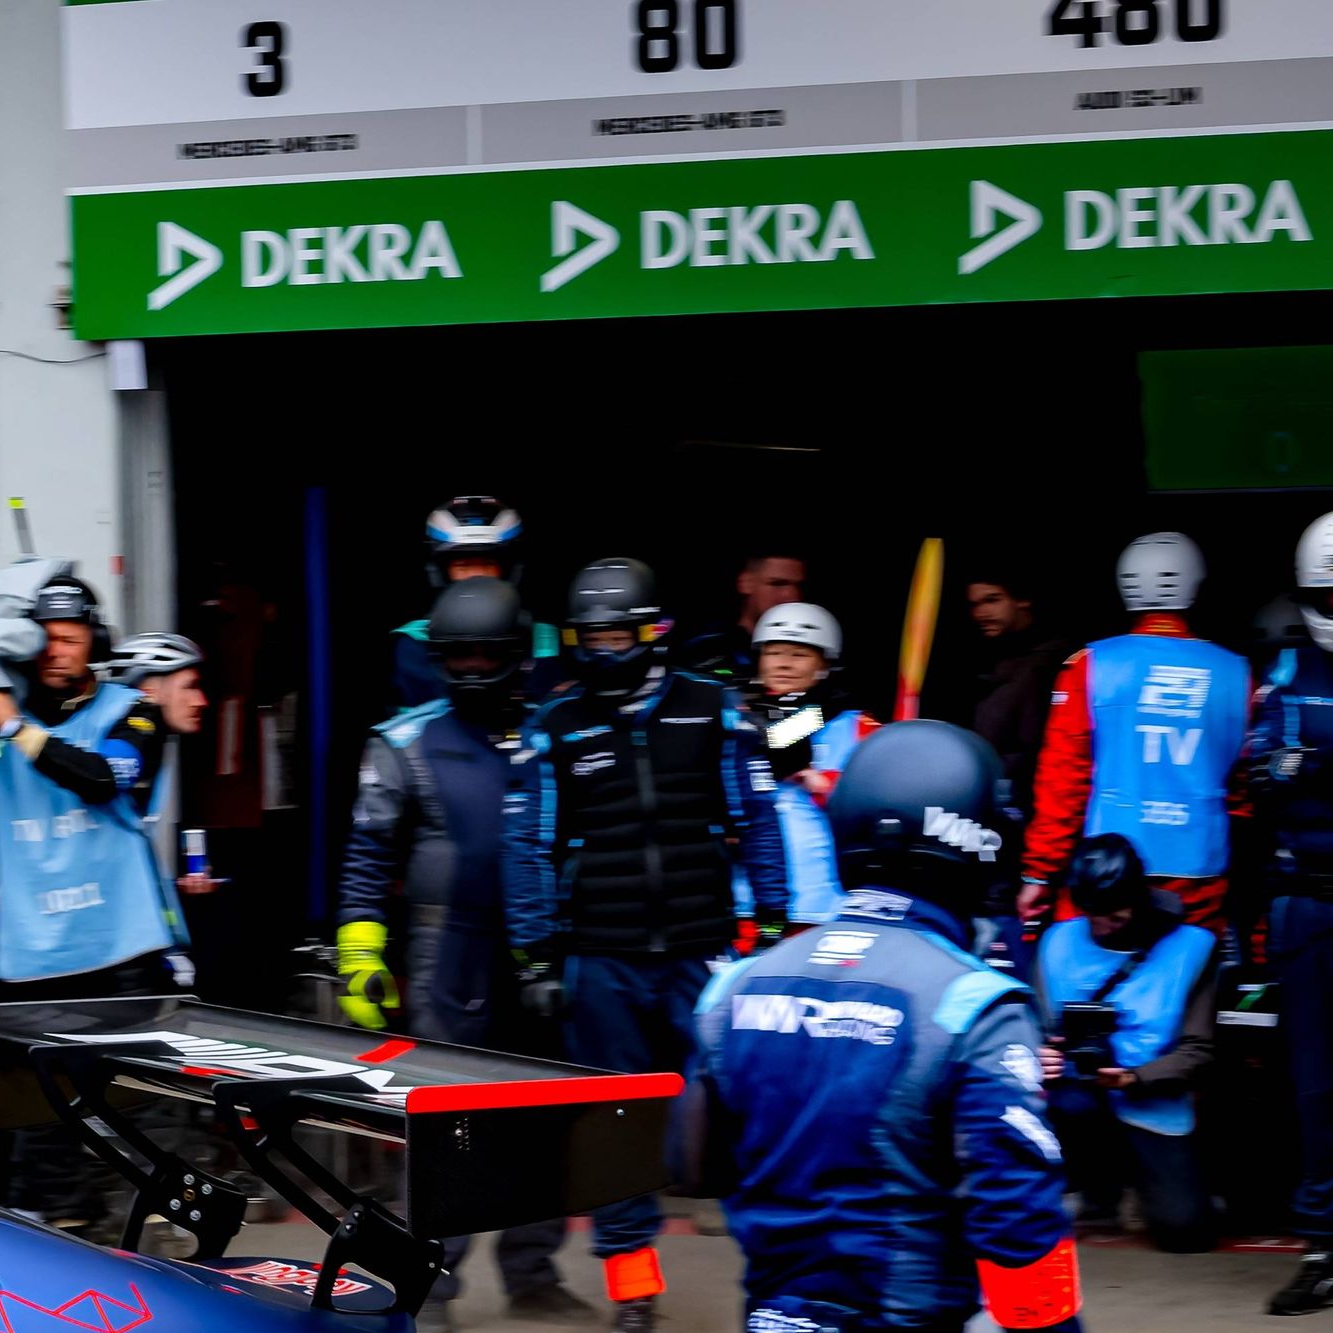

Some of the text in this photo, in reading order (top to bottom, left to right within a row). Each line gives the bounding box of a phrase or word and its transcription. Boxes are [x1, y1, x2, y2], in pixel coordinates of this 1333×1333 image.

[239, 20, 288, 98] 3
[633, 0, 744, 73] 80
[640, 199, 876, 269] DEKRA
[1064, 179, 1313, 251] DEKRA
[241, 220, 464, 288] DEKRA
[1135, 724, 1204, 765] TV
